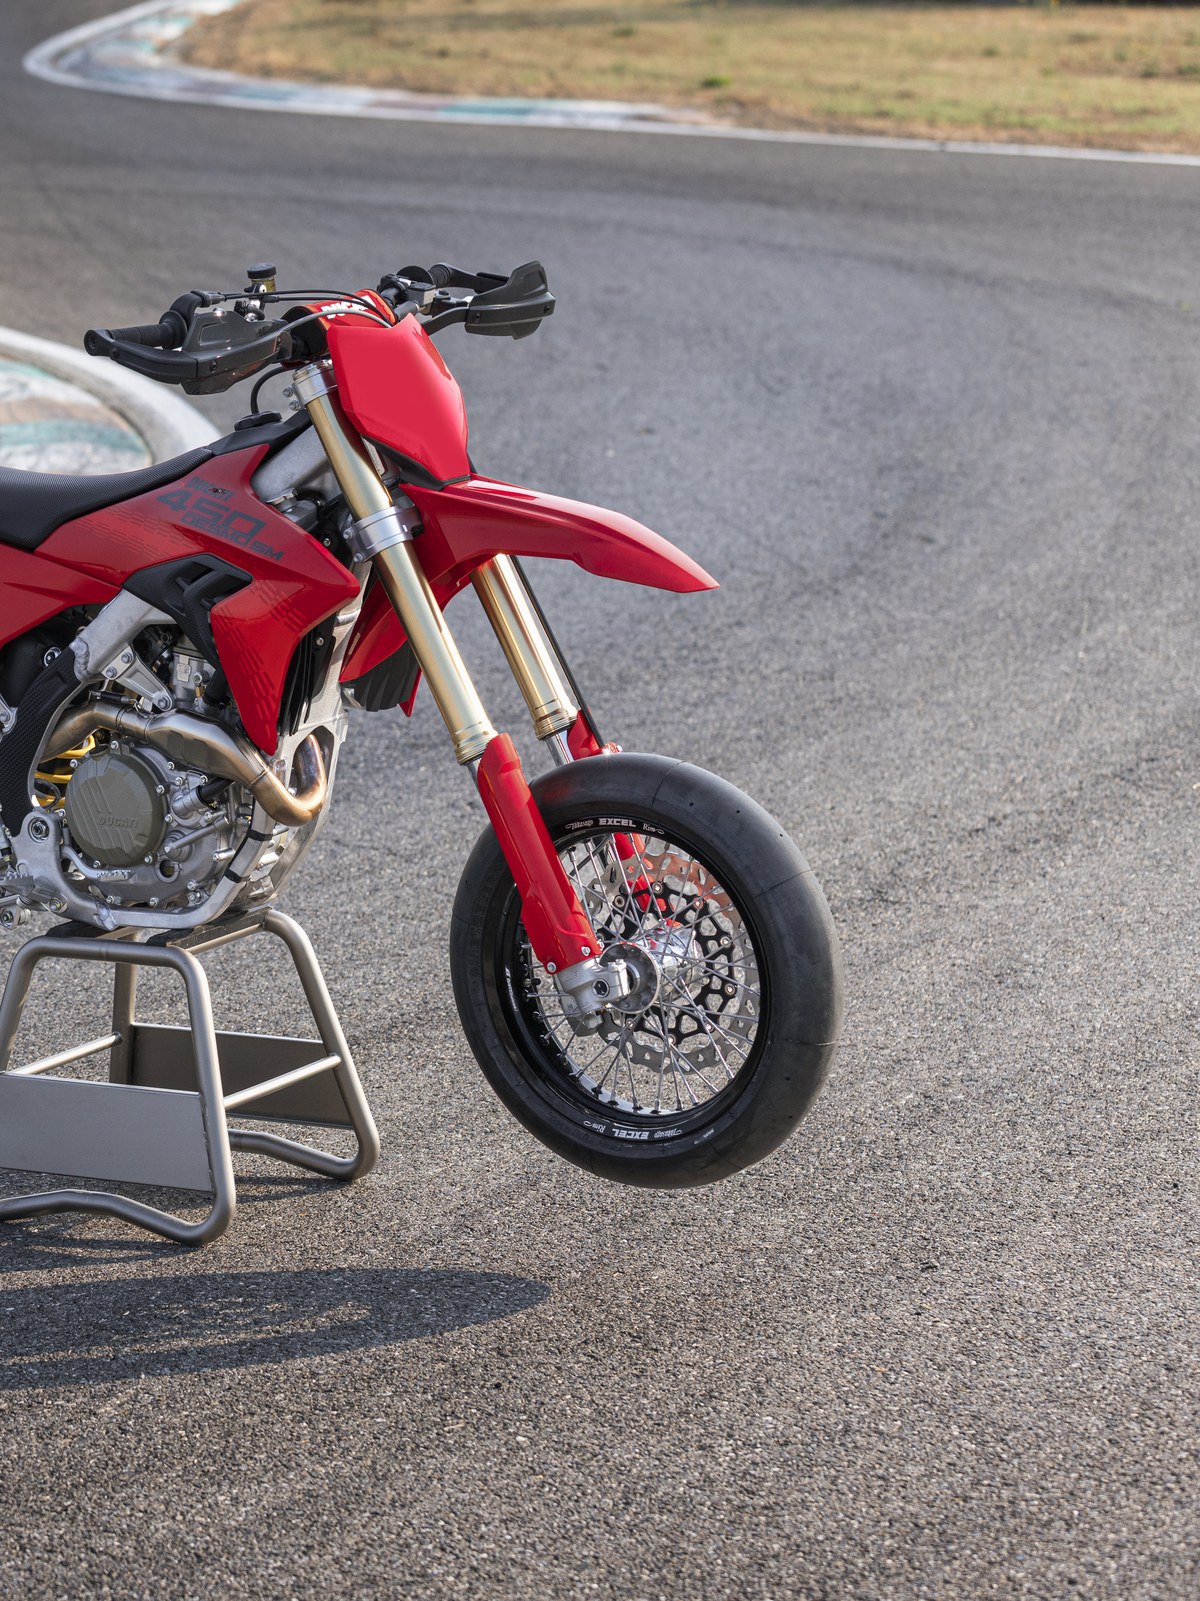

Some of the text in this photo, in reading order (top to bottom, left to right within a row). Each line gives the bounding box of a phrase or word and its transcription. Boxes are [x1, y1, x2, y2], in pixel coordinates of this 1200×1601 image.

[156, 488, 266, 541] 450
[180, 511, 285, 561] DESMO SM
[99, 815, 139, 829] DUCATI
[598, 817, 637, 828] EXCEL
[612, 1128, 650, 1140] EXCEL
